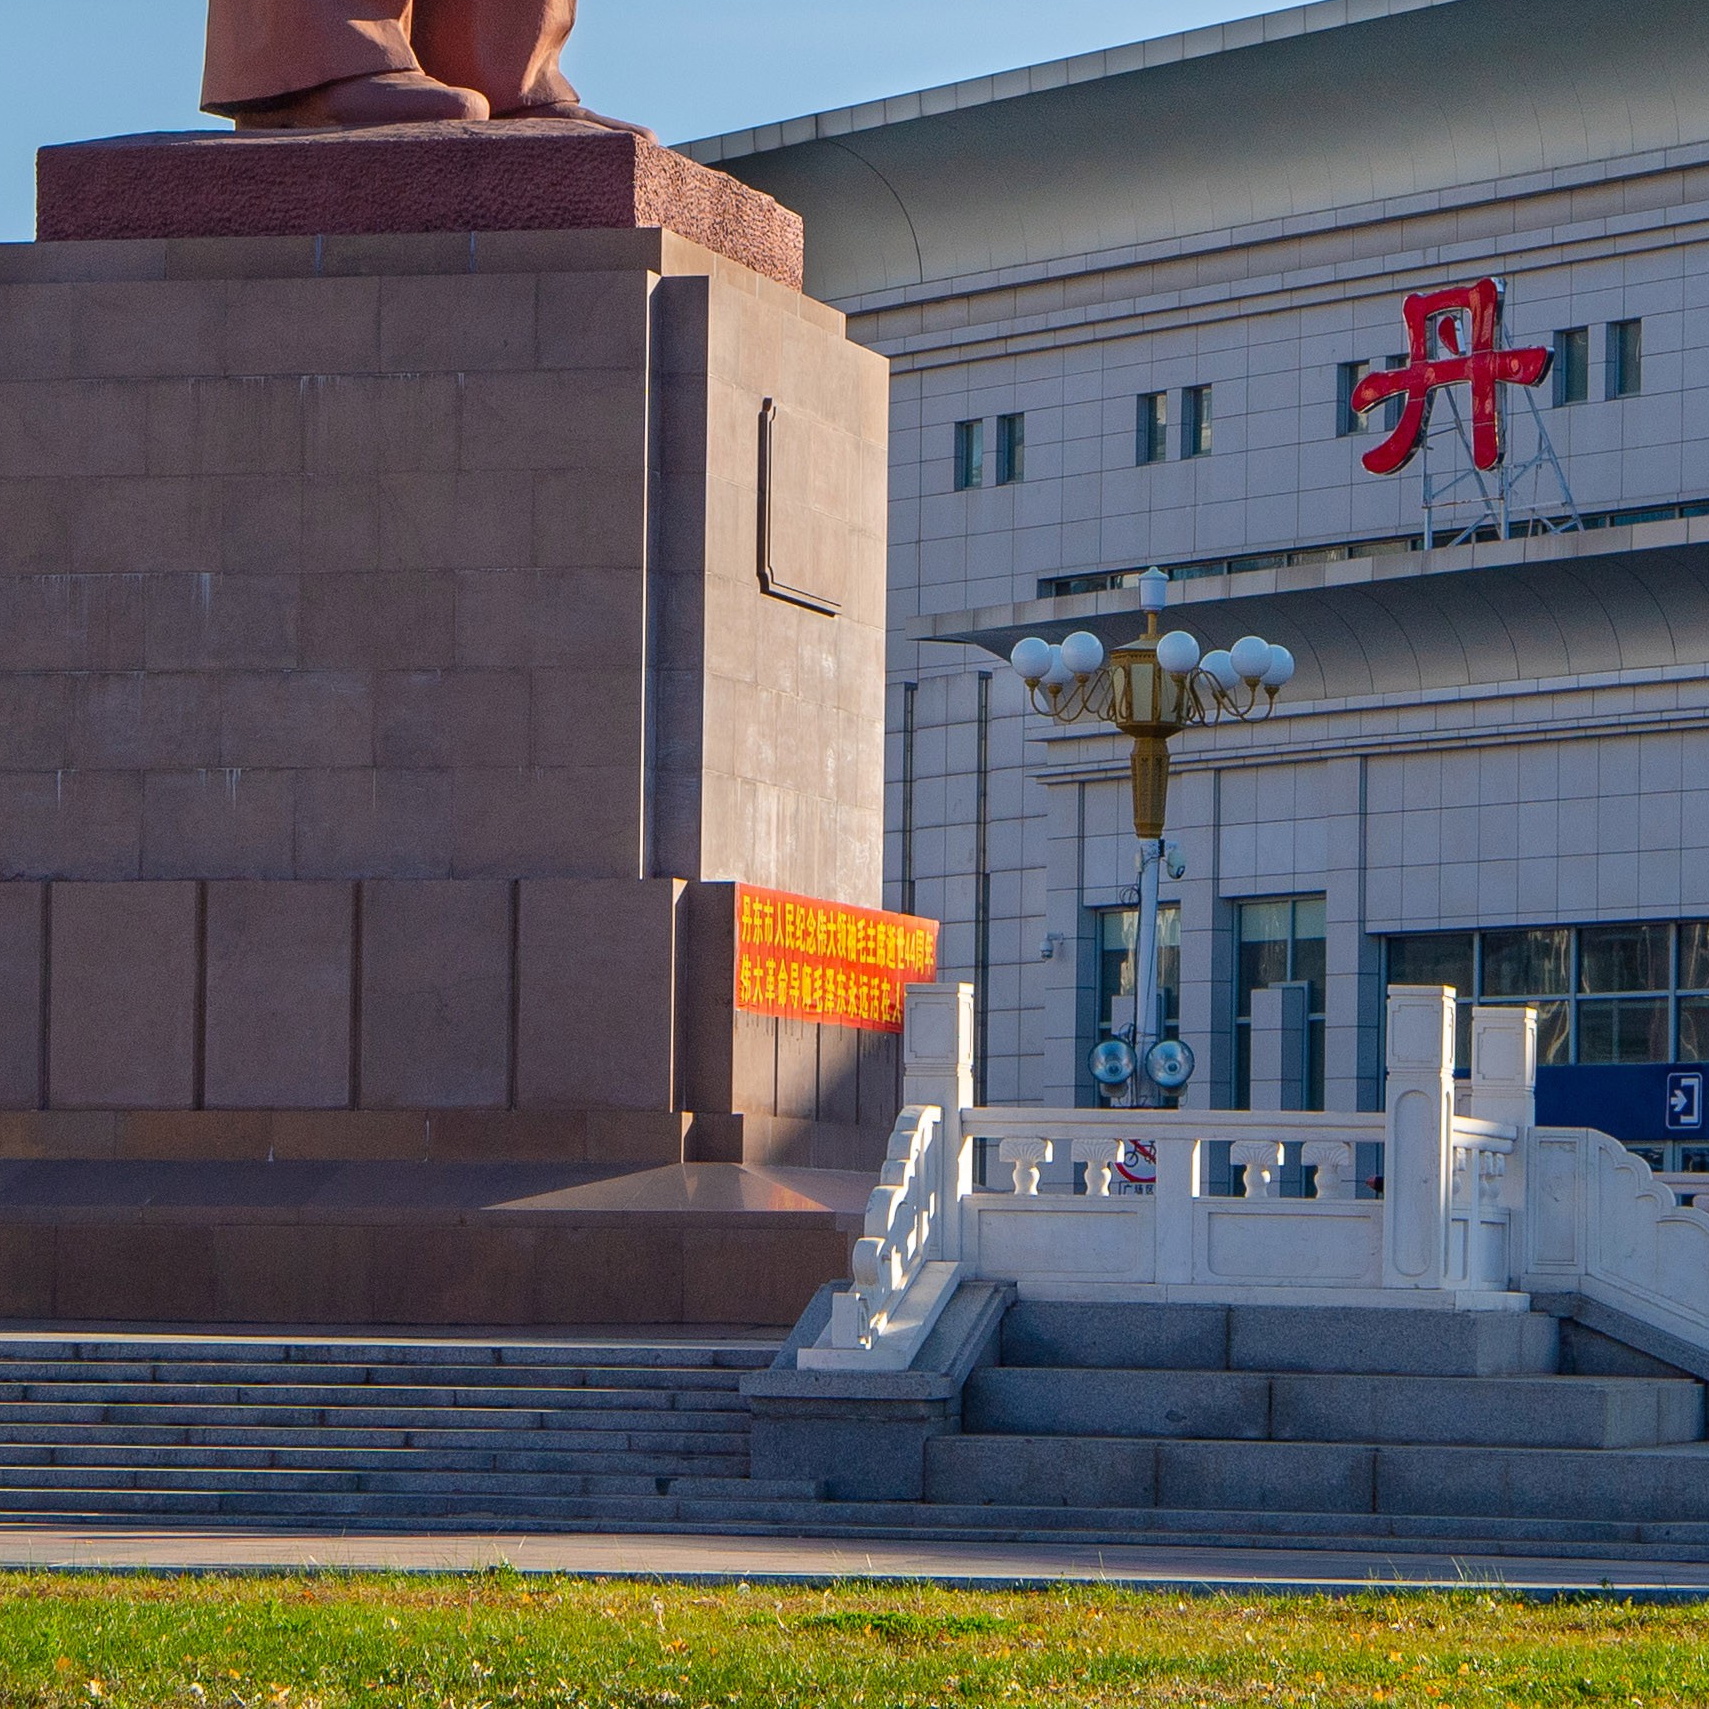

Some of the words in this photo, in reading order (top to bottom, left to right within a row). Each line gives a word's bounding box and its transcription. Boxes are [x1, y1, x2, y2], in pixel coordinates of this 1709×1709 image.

[741, 894, 934, 976] 丹东市人民纪念伟大领袖毛主席逝世44周年
